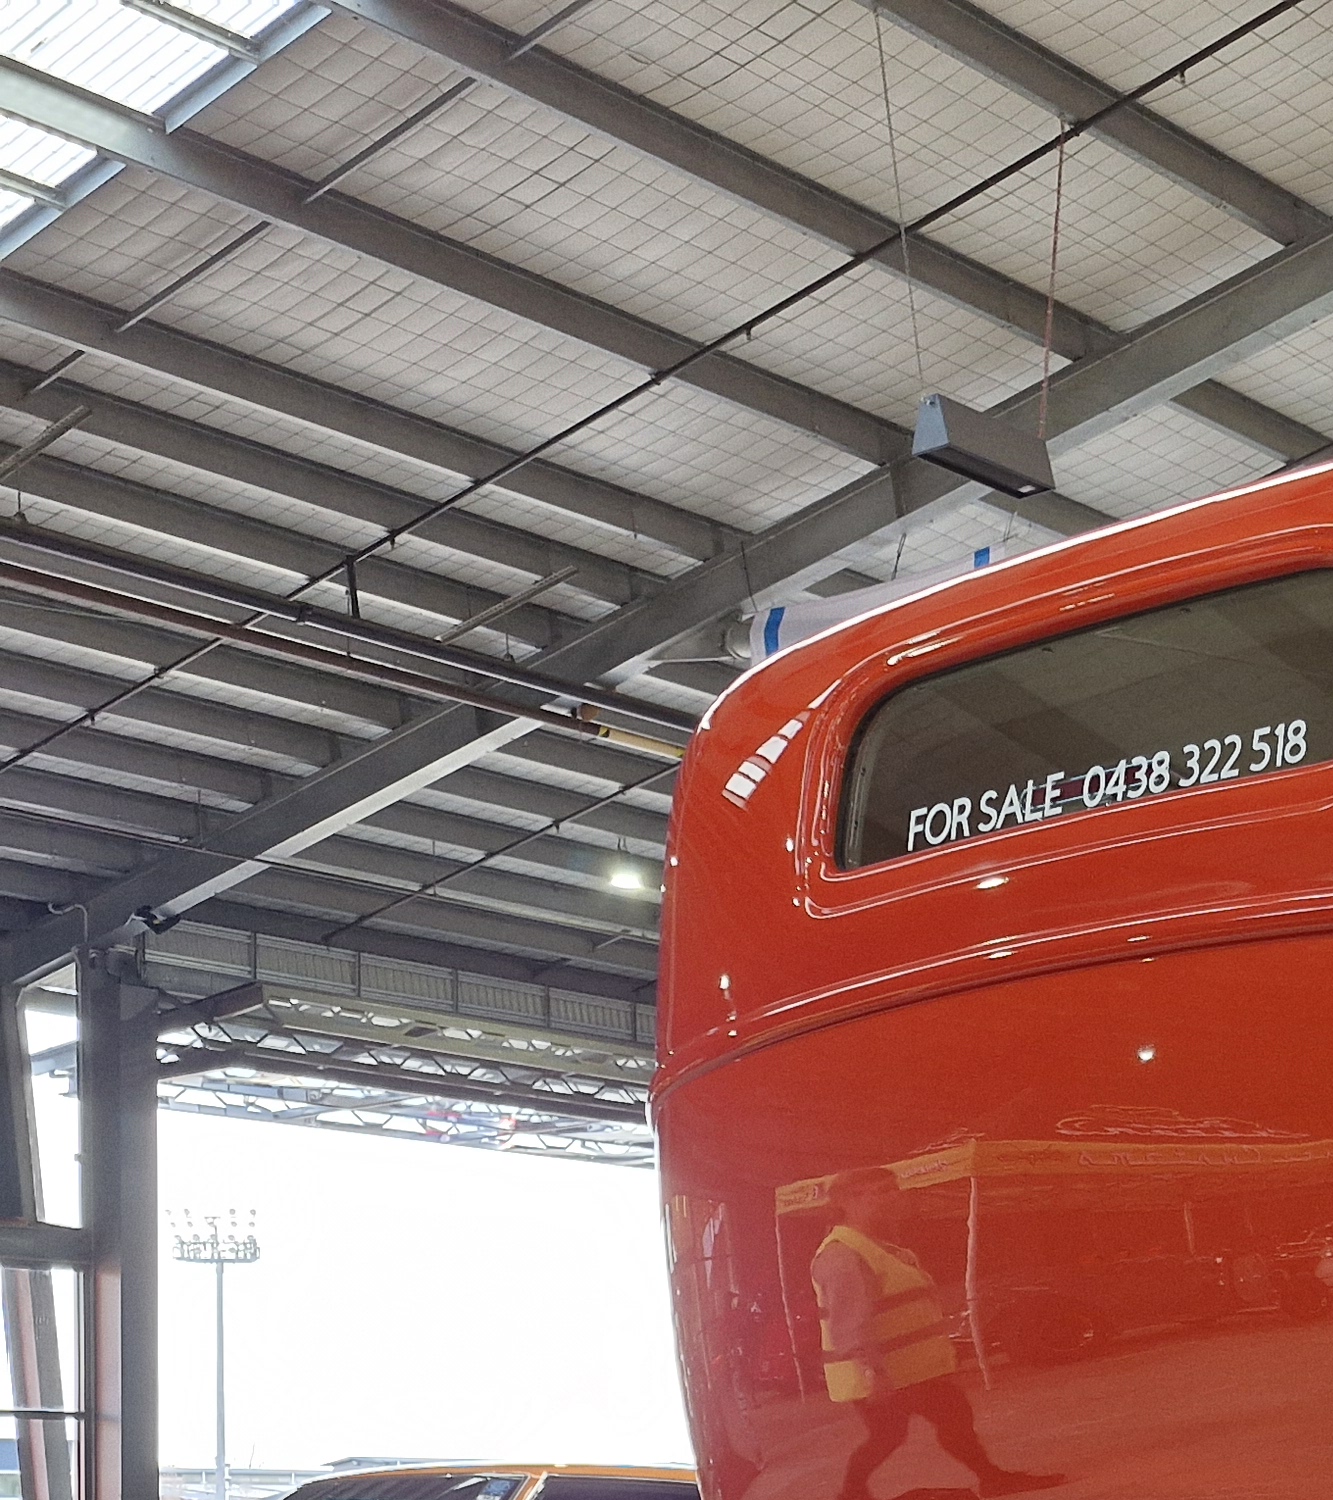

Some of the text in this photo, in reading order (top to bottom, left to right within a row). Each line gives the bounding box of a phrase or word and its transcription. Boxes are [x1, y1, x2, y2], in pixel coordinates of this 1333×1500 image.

[907, 719, 1308, 852] FOR SALE 0438 322 518
